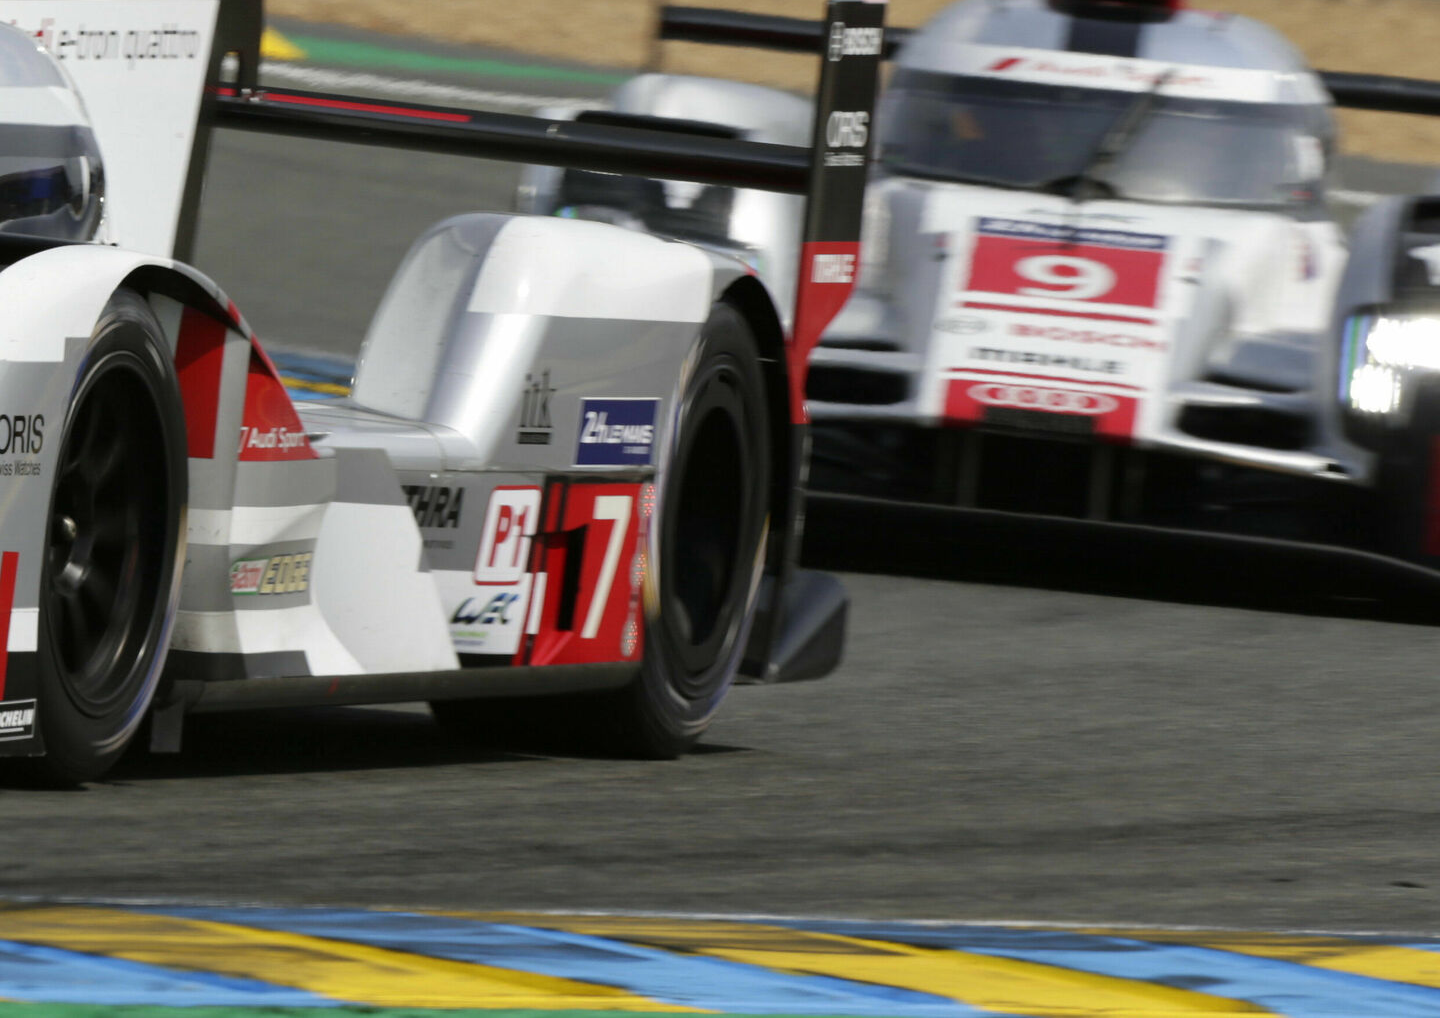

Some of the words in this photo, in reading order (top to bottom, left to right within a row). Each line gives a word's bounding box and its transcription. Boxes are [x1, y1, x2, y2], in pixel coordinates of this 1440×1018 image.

[58, 23, 119, 59] e-tron
[123, 23, 200, 71] quattro
[1012, 254, 1118, 301] 9
[246, 427, 277, 448] Audi
[277, 427, 306, 453] Sport
[14, 459, 41, 476] Watches
[487, 504, 533, 568] P1
[580, 495, 633, 639] 7
